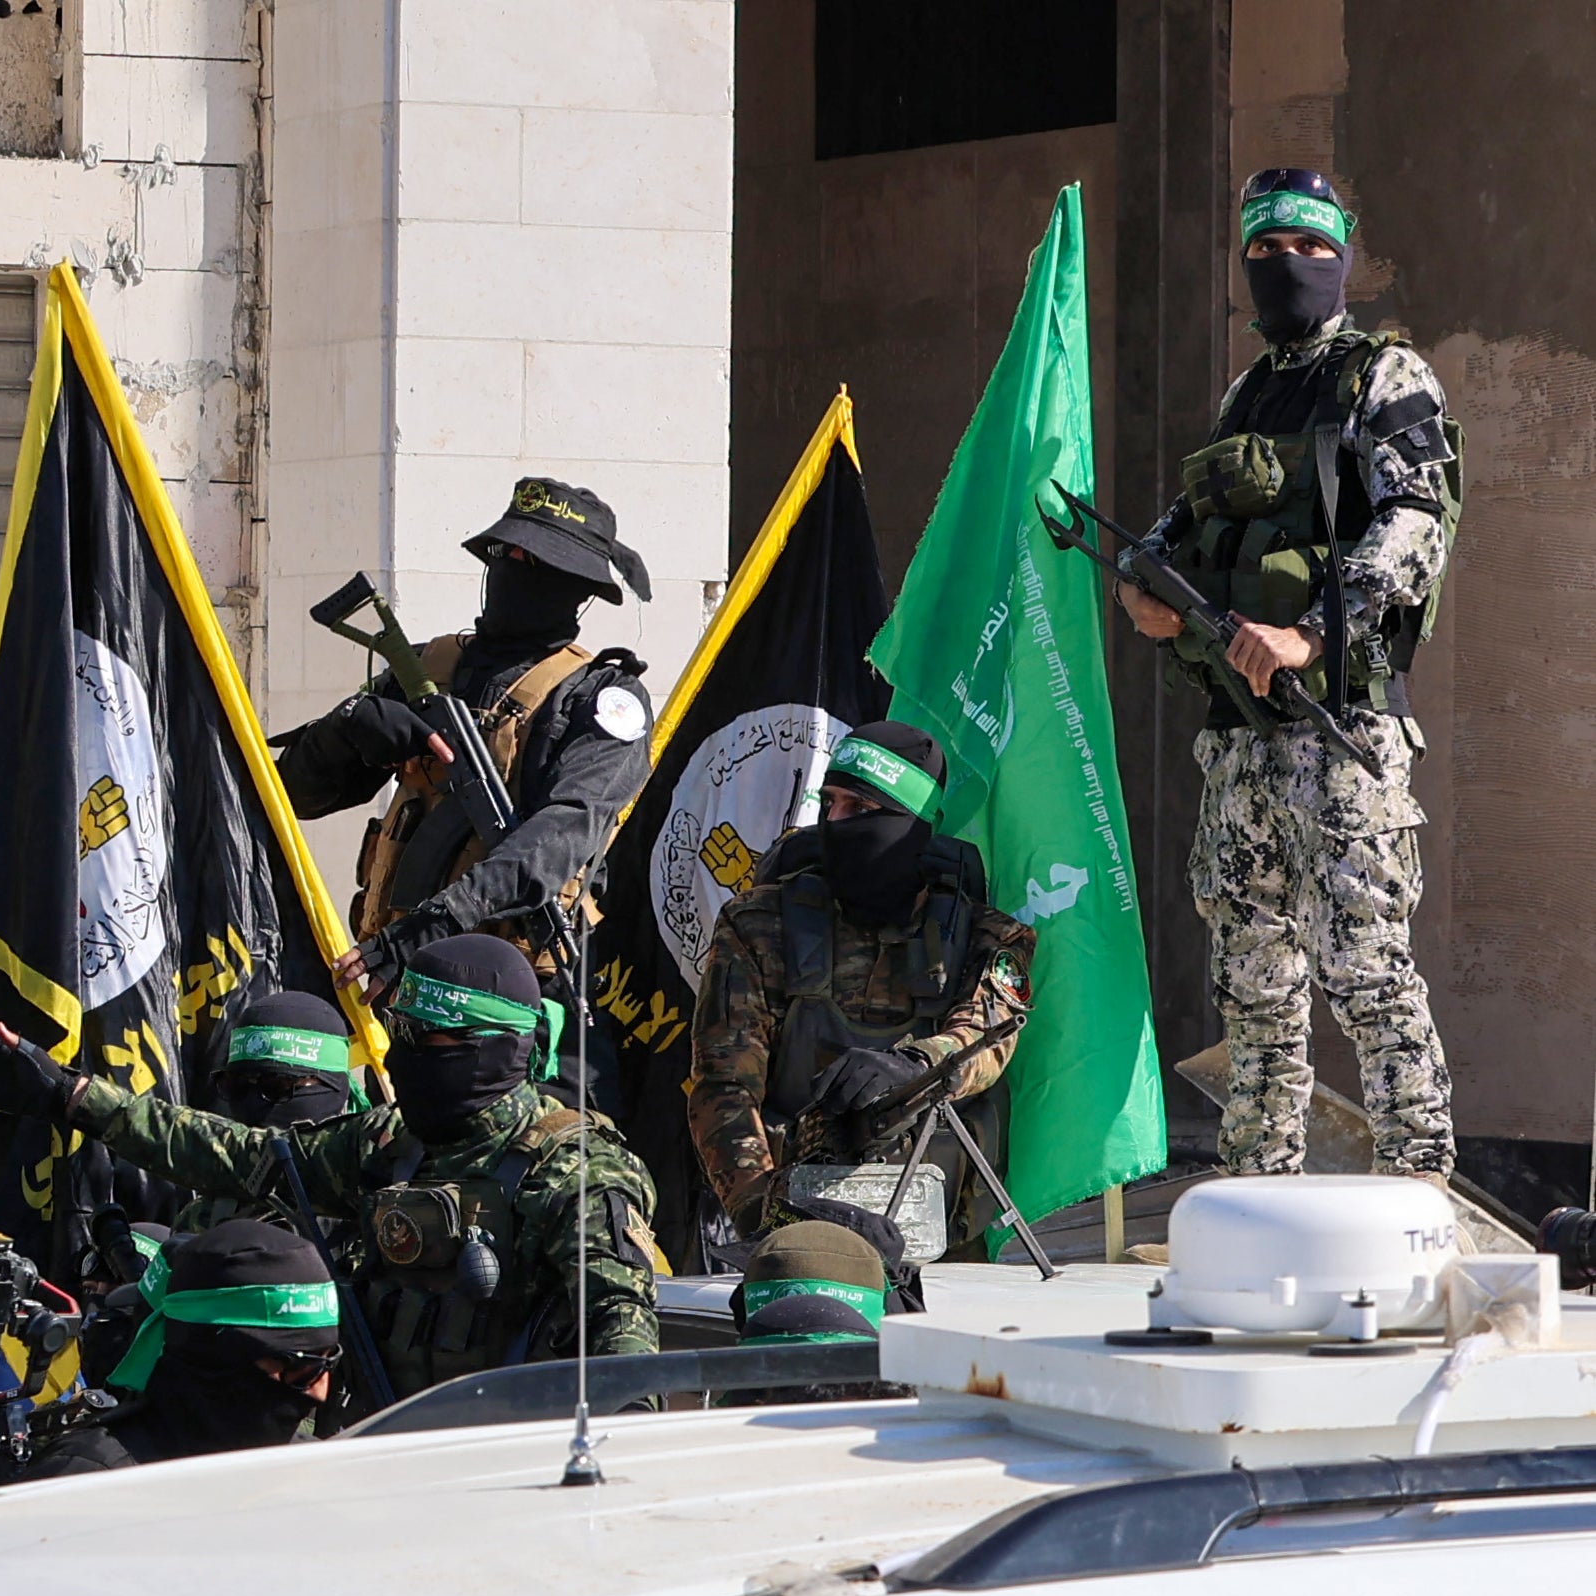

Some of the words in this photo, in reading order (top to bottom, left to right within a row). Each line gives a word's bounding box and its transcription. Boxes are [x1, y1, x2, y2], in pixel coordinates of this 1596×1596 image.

[856, 758, 902, 786] كتائب
[415, 997, 464, 1021] وحدة
[272, 1042, 320, 1062] كتائب
[276, 1297, 324, 1316] القسام
